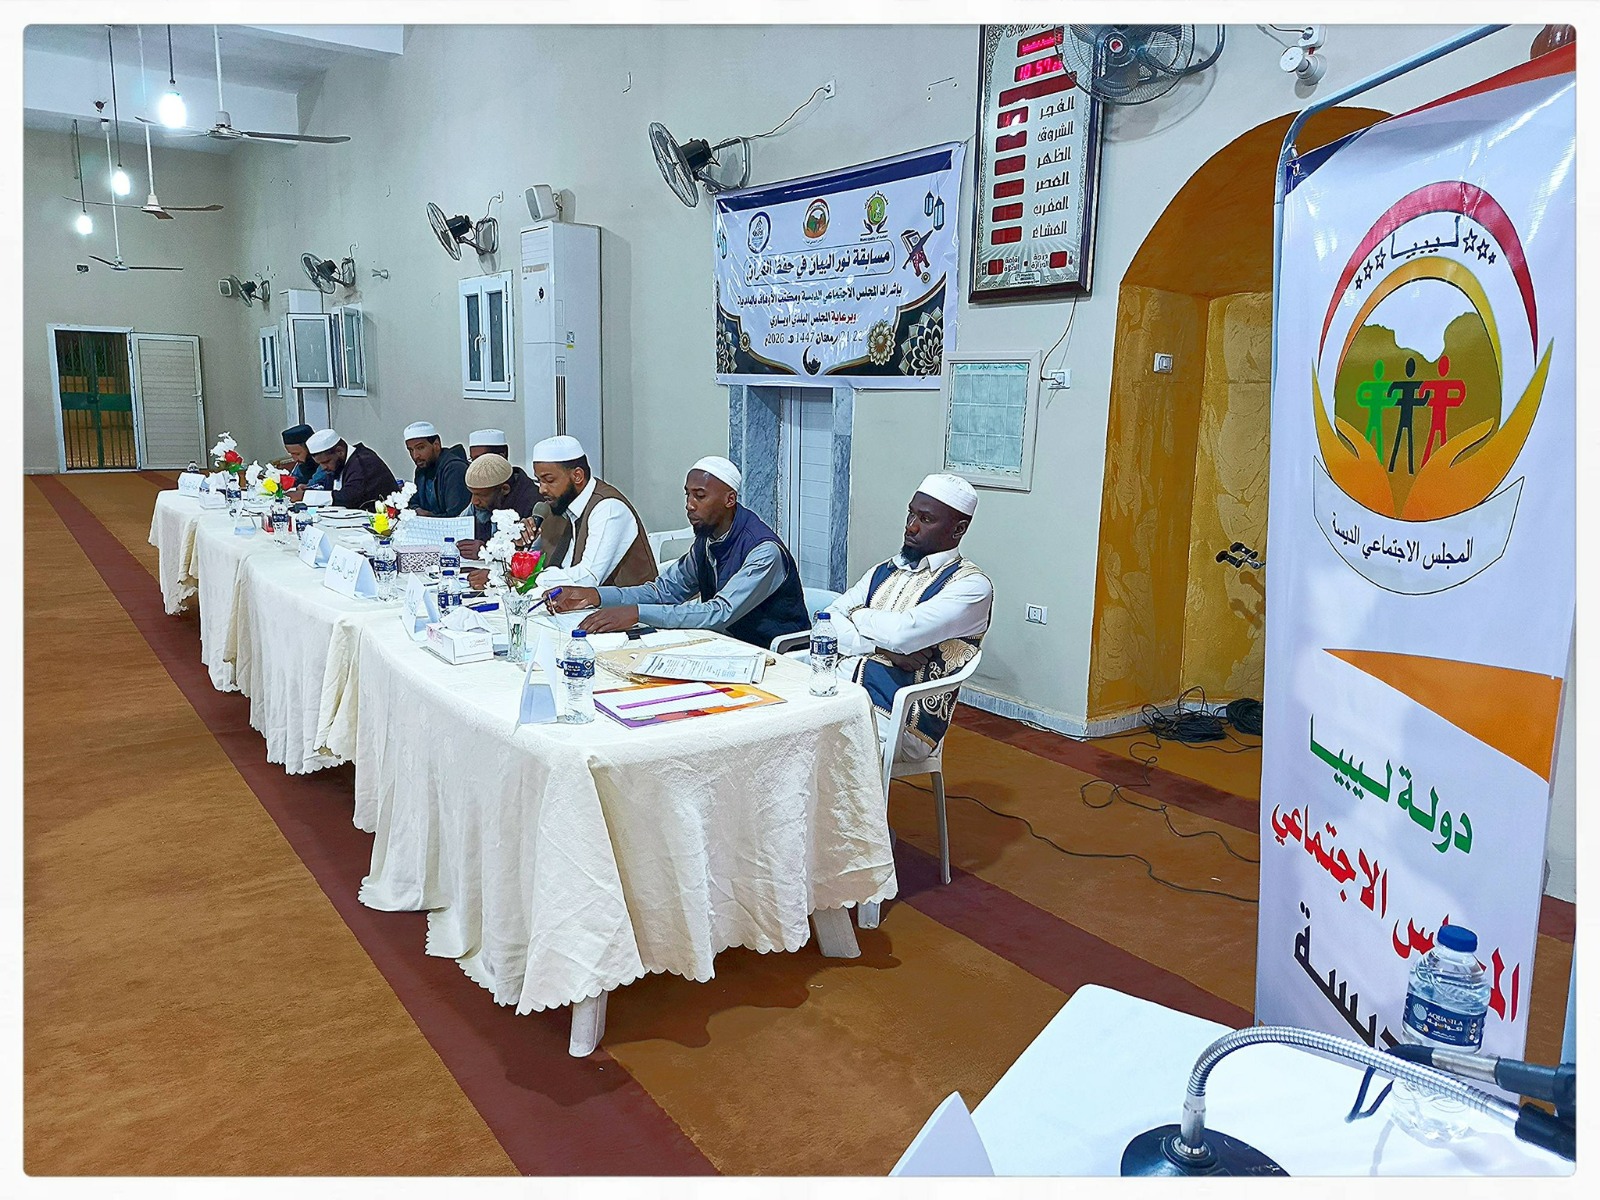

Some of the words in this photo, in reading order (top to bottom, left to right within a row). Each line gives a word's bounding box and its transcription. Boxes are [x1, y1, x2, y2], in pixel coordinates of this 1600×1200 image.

[1040, 95, 1074, 119] الفجر
[1037, 120, 1074, 142] الشروق
[1037, 146, 1071, 168] الظهر
[1035, 170, 1069, 193] العصر
[1033, 195, 1069, 217] المغرب
[1032, 220, 1067, 239] العشاء
[1390, 215, 1461, 260] ليبيا
[773, 256, 794, 275] حفظ
[796, 255, 807, 279] في
[809, 252, 834, 276] البيان
[835, 249, 851, 273] نور
[853, 248, 890, 270] مسابقة
[823, 287, 855, 304] الاجتماعي
[856, 285, 878, 301] المجلس
[811, 312, 831, 326] المجلس
[796, 332, 814, 344] 1447
[815, 332, 839, 345] رمضان
[1362, 534, 1420, 563] الاجتماعي
[1422, 536, 1474, 570] المجلس
[1310, 713, 1393, 803] ليبيا
[1397, 765, 1473, 854] دولة
[1271, 803, 1388, 920] الاجتماعي
